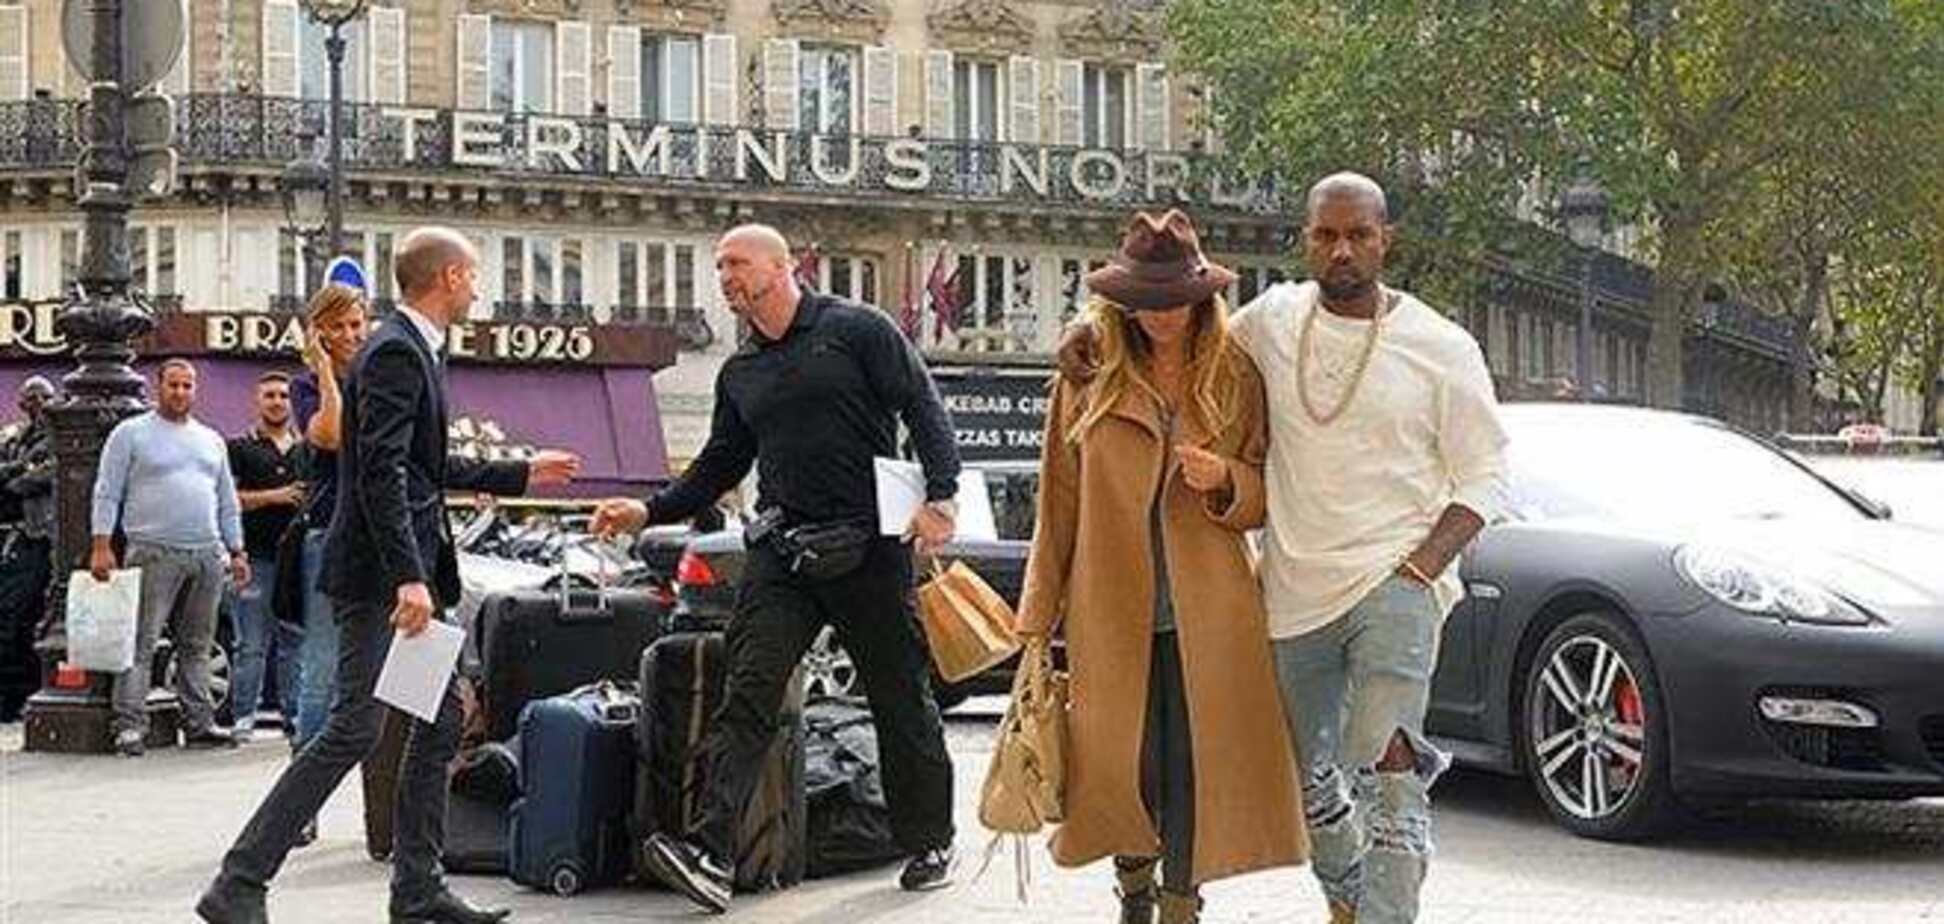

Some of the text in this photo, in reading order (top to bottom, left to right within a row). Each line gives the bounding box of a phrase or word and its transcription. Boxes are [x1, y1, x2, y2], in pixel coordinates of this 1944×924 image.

[380, 107, 1258, 208] TERMINUS NORD
[489, 323, 594, 361] 1925
[943, 395, 1012, 414] KEBAB
